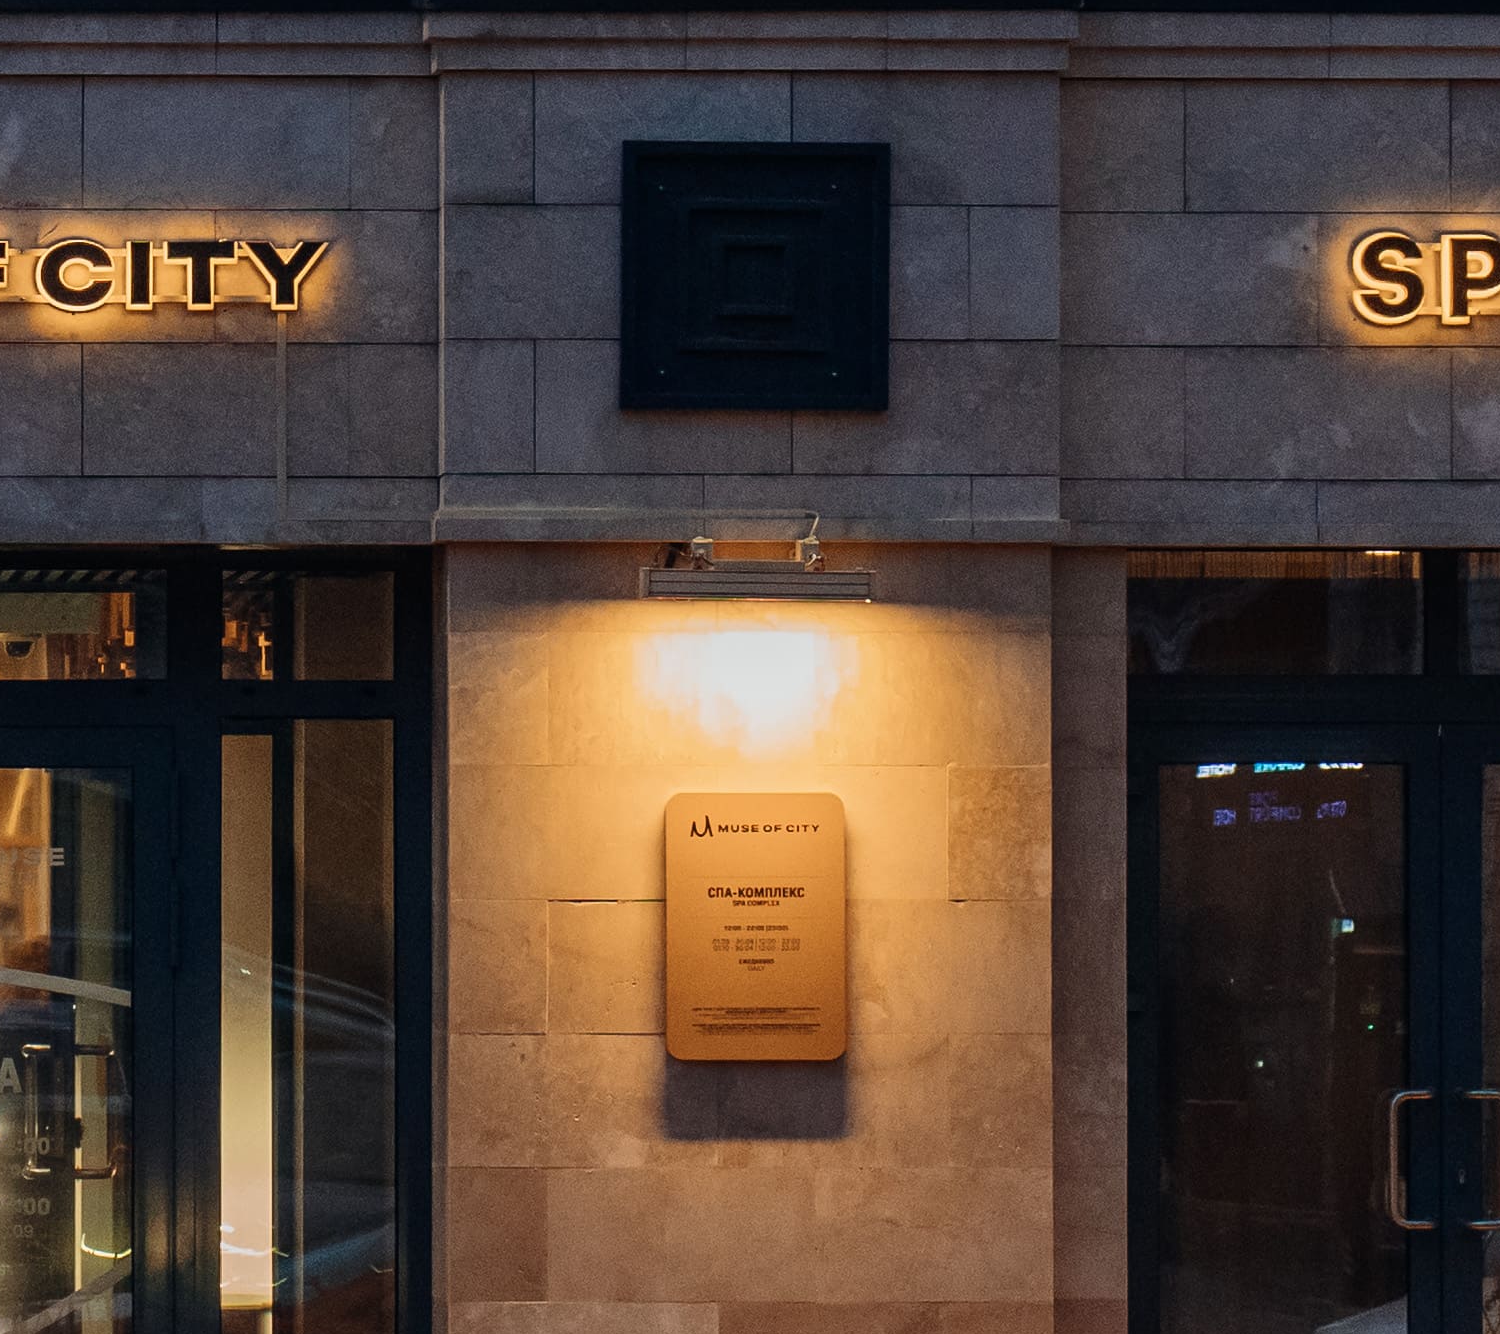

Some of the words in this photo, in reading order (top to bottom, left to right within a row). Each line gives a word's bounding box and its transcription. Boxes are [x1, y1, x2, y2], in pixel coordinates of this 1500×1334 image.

[32, 236, 331, 314] CITY
[717, 823, 760, 834] MUSE
[762, 823, 783, 834] OF
[785, 823, 820, 834] CITY
[707, 886, 806, 899] СПА-КОМПЛЕКС
